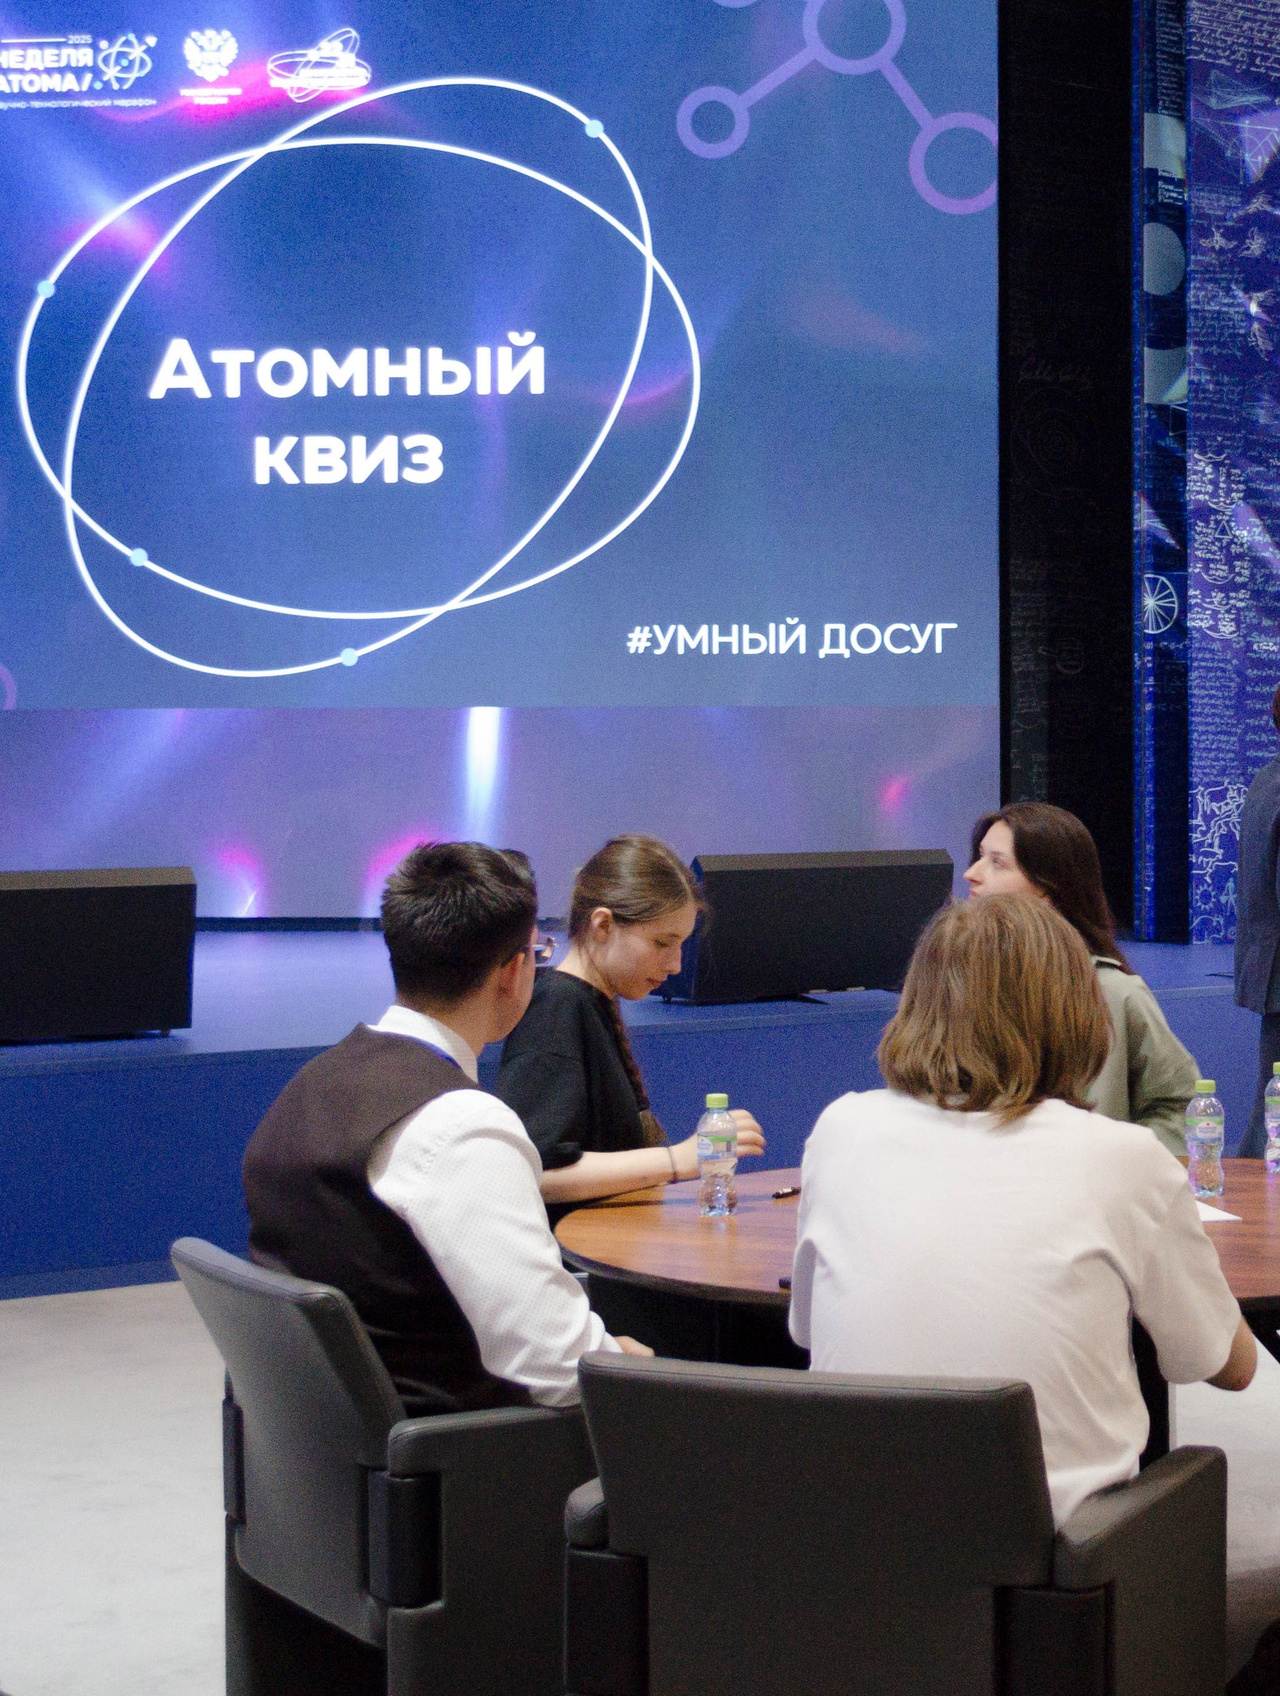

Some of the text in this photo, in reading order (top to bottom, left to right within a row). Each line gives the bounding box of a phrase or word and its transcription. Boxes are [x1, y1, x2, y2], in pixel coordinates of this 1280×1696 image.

[67, 34, 93, 45] 2025
[0, 48, 94, 71] НЕДЕЛЯ
[626, 616, 959, 659] #УМНЫЙ ДОСУГ
